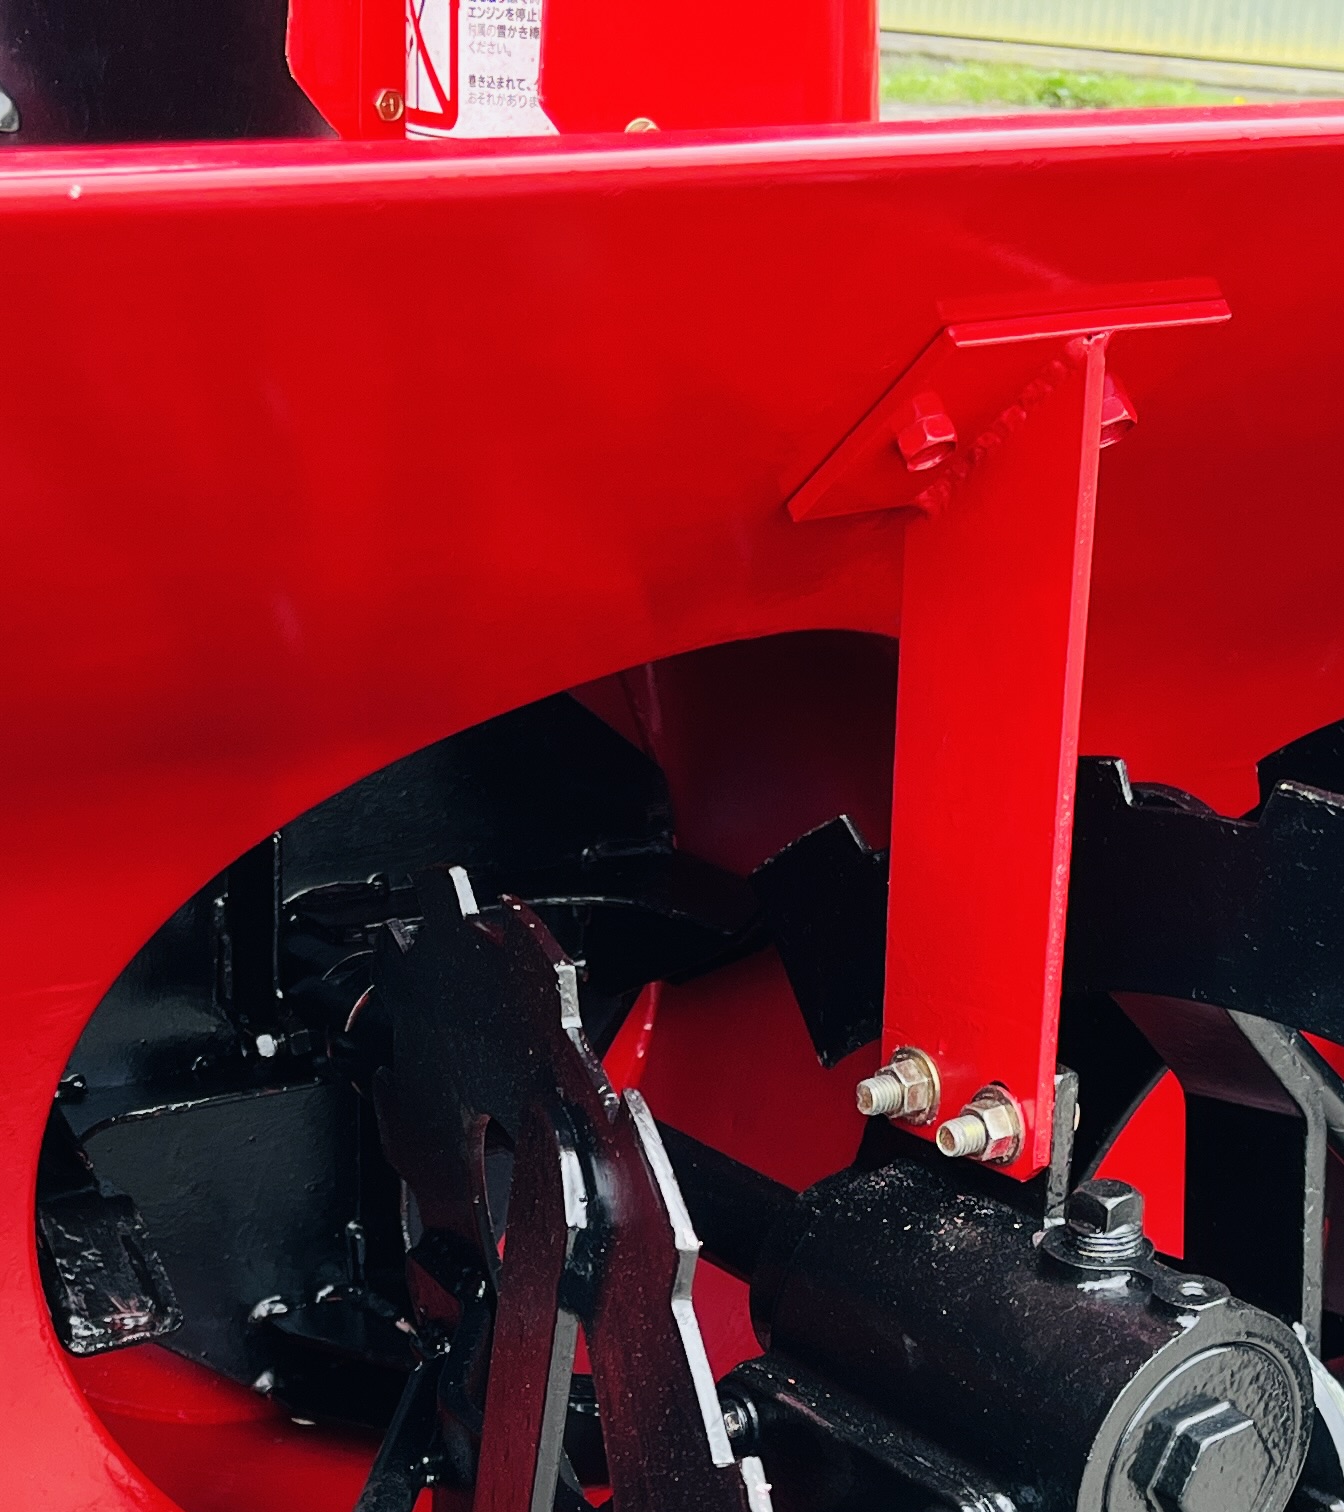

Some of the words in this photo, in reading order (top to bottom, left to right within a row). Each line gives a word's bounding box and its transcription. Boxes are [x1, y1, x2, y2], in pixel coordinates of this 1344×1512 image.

[468, 74, 539, 91] 巻き込まれて、
